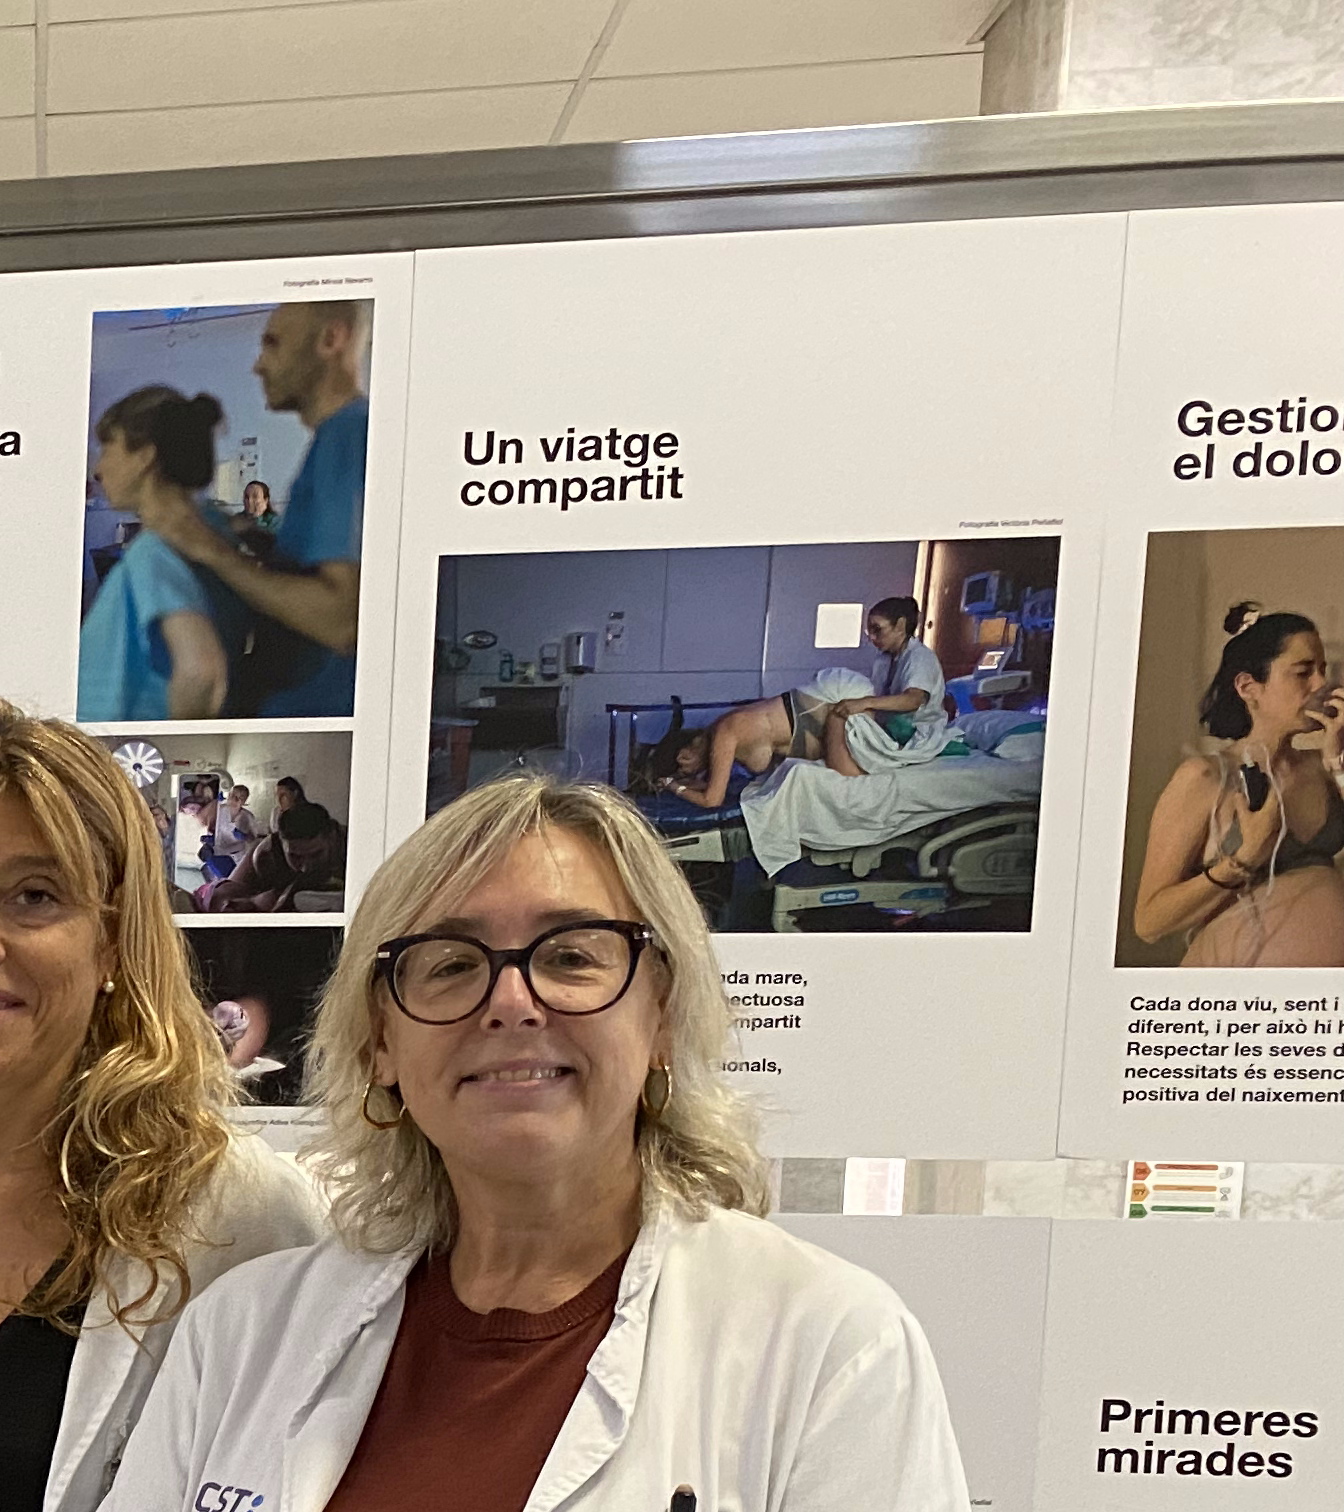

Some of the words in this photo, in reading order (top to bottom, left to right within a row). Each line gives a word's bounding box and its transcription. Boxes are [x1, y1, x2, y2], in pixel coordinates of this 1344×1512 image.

[1178, 397, 1344, 437] Gestio
[464, 431, 523, 465] Un
[540, 428, 678, 468] viatge
[1174, 444, 1215, 480] el
[1233, 440, 1341, 478] dolo
[461, 465, 684, 511] compartit
[756, 974, 807, 987] mare,
[730, 993, 804, 1006] ectuosa
[1130, 996, 1181, 1011] Cada
[1188, 997, 1237, 1011] dona
[1244, 997, 1277, 1013] viu,
[1284, 998, 1327, 1011] sent
[1334, 997, 1339, 1011] i
[1128, 1019, 1209, 1036] diferent,
[1216, 1020, 1220, 1034] i
[1227, 1023, 1261, 1037] per
[1266, 1019, 1307, 1034] això
[1314, 1020, 1331, 1034] hi
[1127, 1042, 1229, 1059] Respectar
[1235, 1042, 1262, 1057] les
[1269, 1046, 1326, 1057] seves
[1125, 1065, 1237, 1079] necessitats
[1244, 1063, 1266, 1079] és
[1273, 1069, 1344, 1080] essenc
[1123, 1087, 1199, 1104] positiva
[1206, 1087, 1235, 1101] del
[1101, 1399, 1318, 1438] Primeres
[1097, 1441, 1292, 1478] mirades
